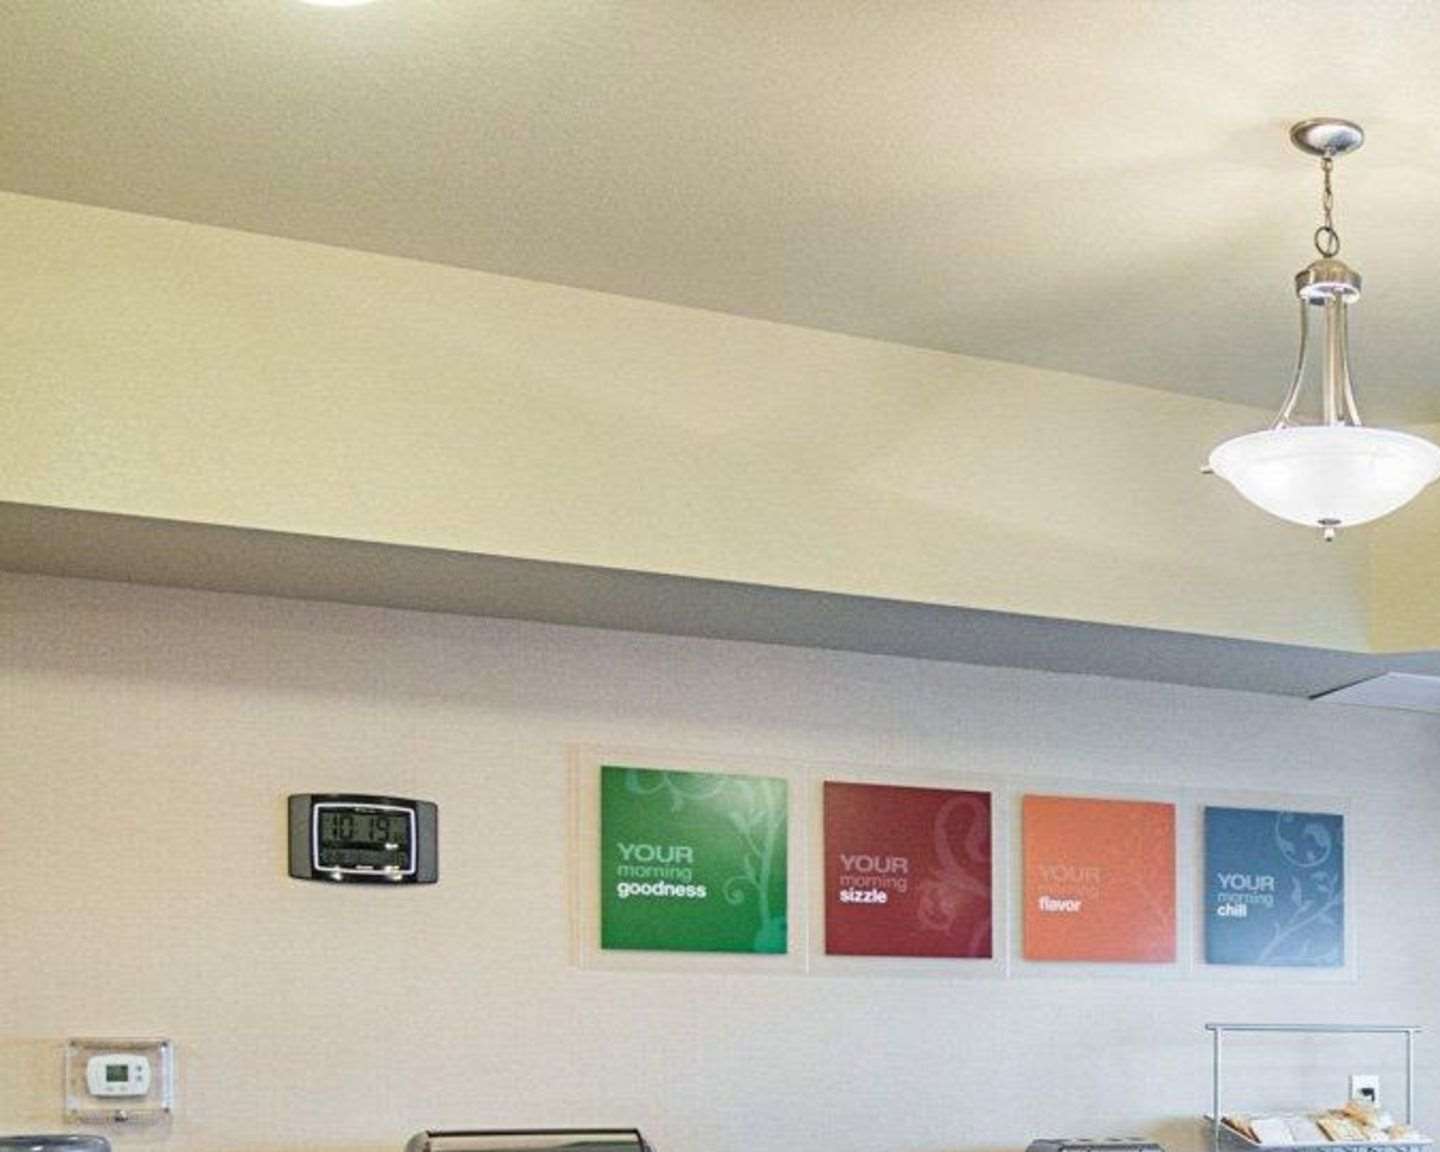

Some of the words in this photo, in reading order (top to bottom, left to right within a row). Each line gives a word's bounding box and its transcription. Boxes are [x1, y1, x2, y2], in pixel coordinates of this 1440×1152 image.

[616, 842, 694, 863] YOUR
[840, 854, 909, 873] YOUR
[617, 864, 692, 883] morning
[1217, 872, 1275, 891] YOUR
[617, 880, 707, 899] goodness
[840, 875, 908, 893] morning
[840, 887, 887, 903] sizzle
[1039, 895, 1082, 912] flavor
[1217, 892, 1274, 908] morning
[1217, 902, 1247, 918] chill
